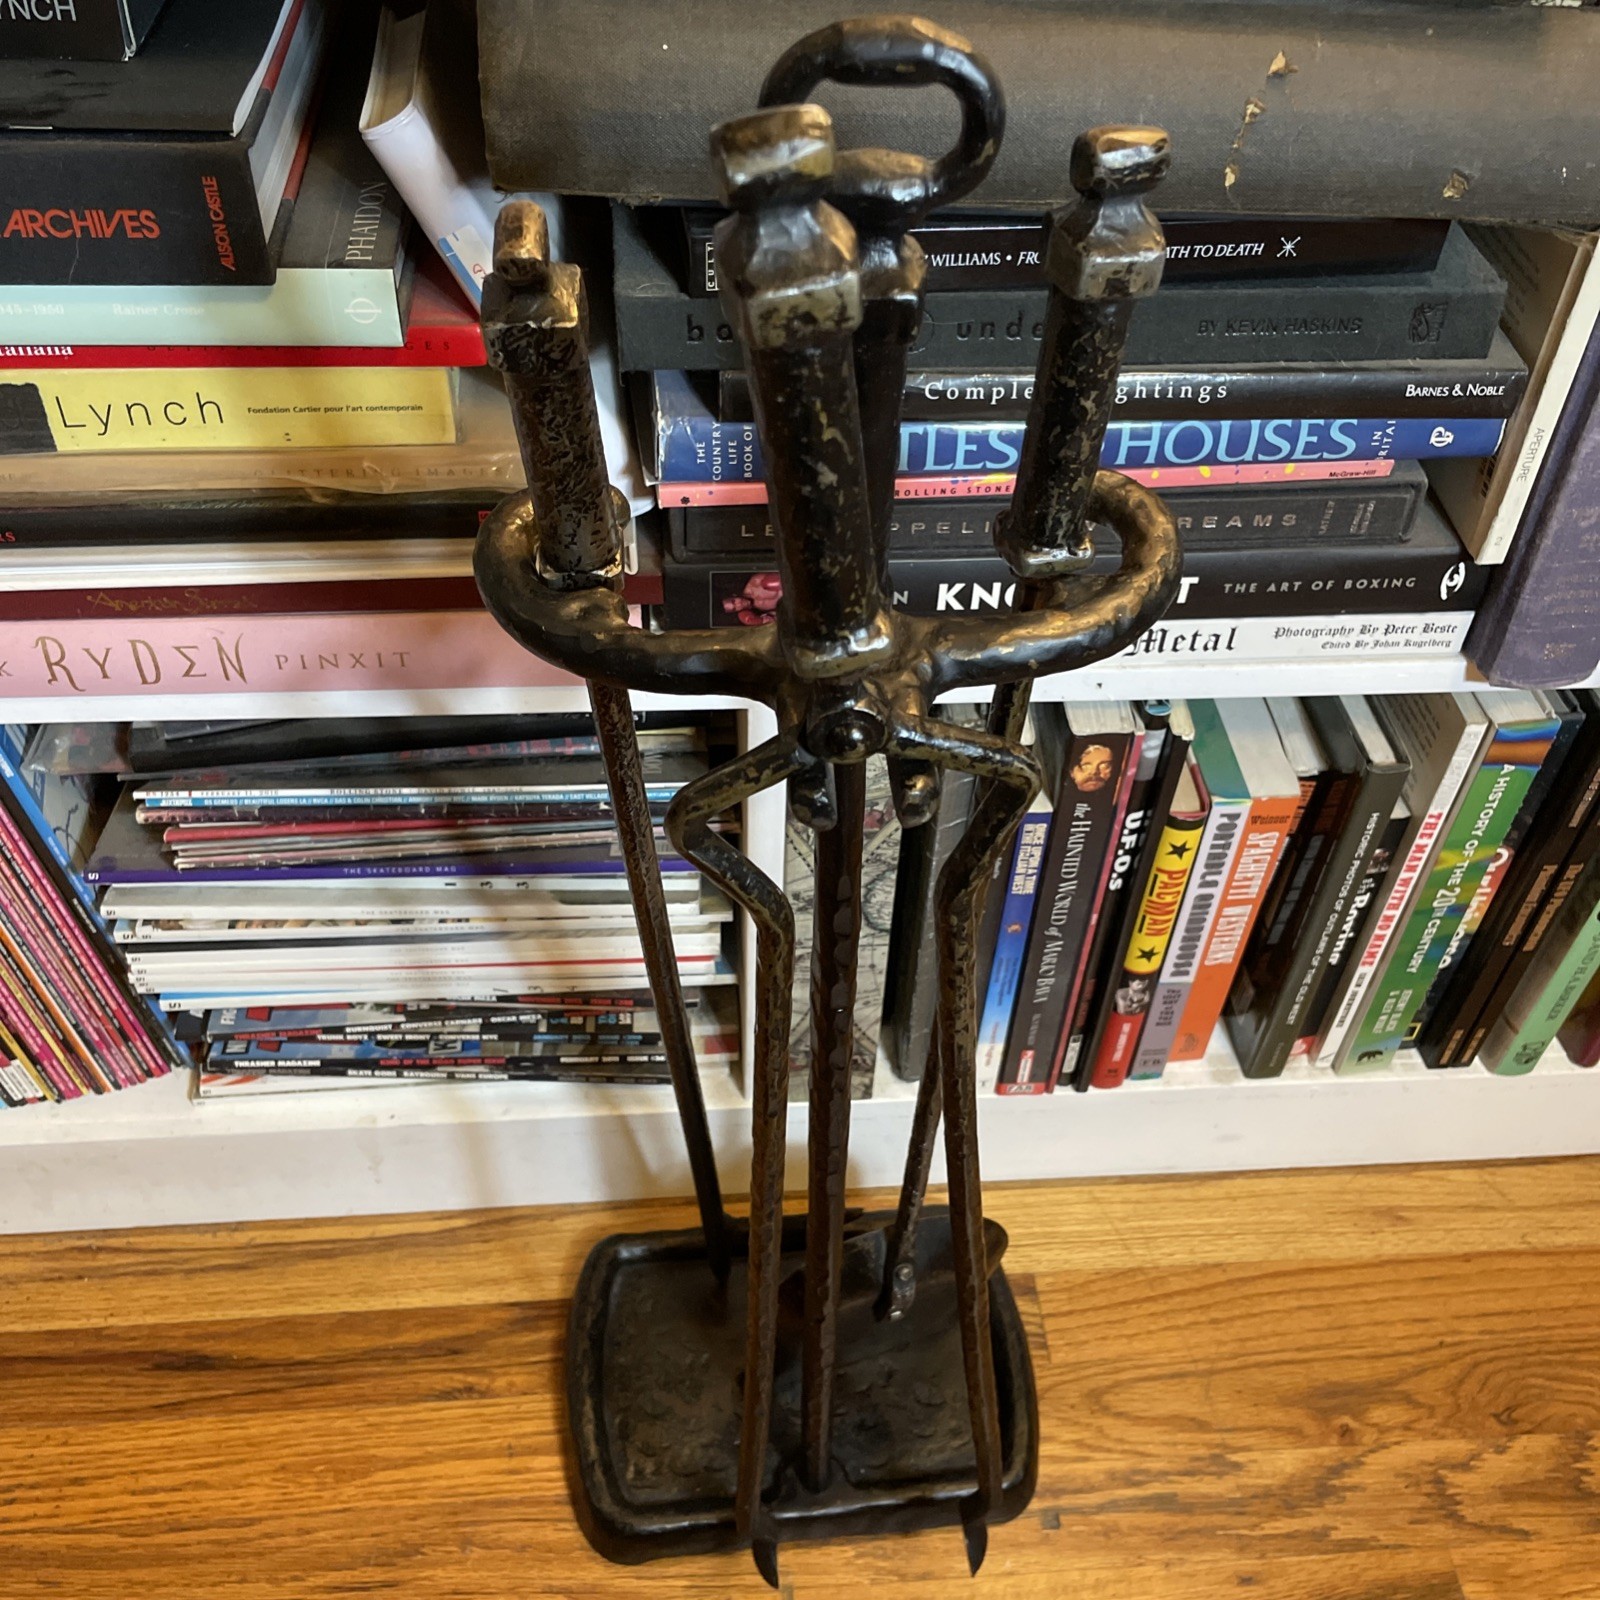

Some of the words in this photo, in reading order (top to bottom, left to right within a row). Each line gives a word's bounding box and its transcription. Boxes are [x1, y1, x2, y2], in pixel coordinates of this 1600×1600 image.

[0, 0, 77, 21] NCH
[202, 176, 225, 222] CASTLE
[4, 209, 161, 240] ARCHIVES
[345, 181, 387, 261] PHAIDON
[212, 223, 236, 271] ALISON
[931, 252, 1001, 267] WILLIAMS
[1193, 246, 1213, 258] TO
[1215, 243, 1265, 257] DEATH
[1197, 319, 1216, 336] BY
[1225, 318, 1278, 336] KEVIN
[1285, 317, 1363, 335] HASKINS
[1405, 384, 1449, 397] BARNES
[1452, 383, 1464, 396] &
[1466, 383, 1505, 396] NOBLE
[55, 392, 224, 436] Lynch
[247, 407, 291, 415] Fondation
[293, 405, 322, 414] Cartier
[324, 407, 344, 416] pour
[365, 404, 423, 414] contemporain
[712, 421, 722, 481] COUNTRY
[728, 440, 737, 465] LIFE
[1114, 418, 1358, 466] HOUSES
[1371, 431, 1383, 446] IN
[697, 442, 706, 464] THE
[744, 445, 753, 478] BOOK
[1515, 427, 1546, 483] APERTURE
[1329, 469, 1377, 478] McGraw-Hill
[895, 488, 957, 497] ROLLING
[966, 484, 1012, 494] STONE
[1223, 583, 1258, 594] THE
[1266, 581, 1303, 593] ART
[1311, 580, 1335, 591] OF
[1344, 577, 1417, 590] BOXING
[1122, 625, 1239, 657] Metal
[1274, 625, 1355, 640] Photography
[1358, 623, 1380, 638] By
[1384, 623, 1418, 639] Peter
[1422, 622, 1458, 635] Beste
[1321, 640, 1351, 650] Edited
[1403, 637, 1452, 649] Kugelberg
[275, 651, 412, 671] PINXIT
[1501, 764, 1516, 775] A
[1074, 803, 1091, 819] the
[1476, 776, 1511, 838] HISTORY
[1355, 812, 1380, 858] HISTORIC
[1419, 812, 1443, 840] THE
[1061, 821, 1092, 879] HAUNTED
[1402, 843, 1427, 874] MAN
[1461, 839, 1479, 859] OF
[343, 867, 362, 875] THE
[366, 866, 431, 875] SKATEBOARD
[436, 865, 457, 873] MAG
[1226, 831, 1280, 900] SPAGHETTI
[1338, 860, 1360, 899] PHOTOS
[1447, 859, 1471, 887] THE
[1050, 881, 1078, 926] WORLD
[1143, 867, 1188, 936] PACMAN
[1333, 899, 1345, 912] OF
[1386, 874, 1411, 912] WITH
[1204, 904, 1253, 967] WESTERNS
[1315, 912, 1339, 955] OUTLAWS
[1376, 913, 1396, 932] NO
[1360, 932, 1389, 968] NAME
[1406, 919, 1441, 974] CENTURY
[234, 1060, 276, 1068] THRASHER
[277, 1059, 321, 1067] MAGAZINE
